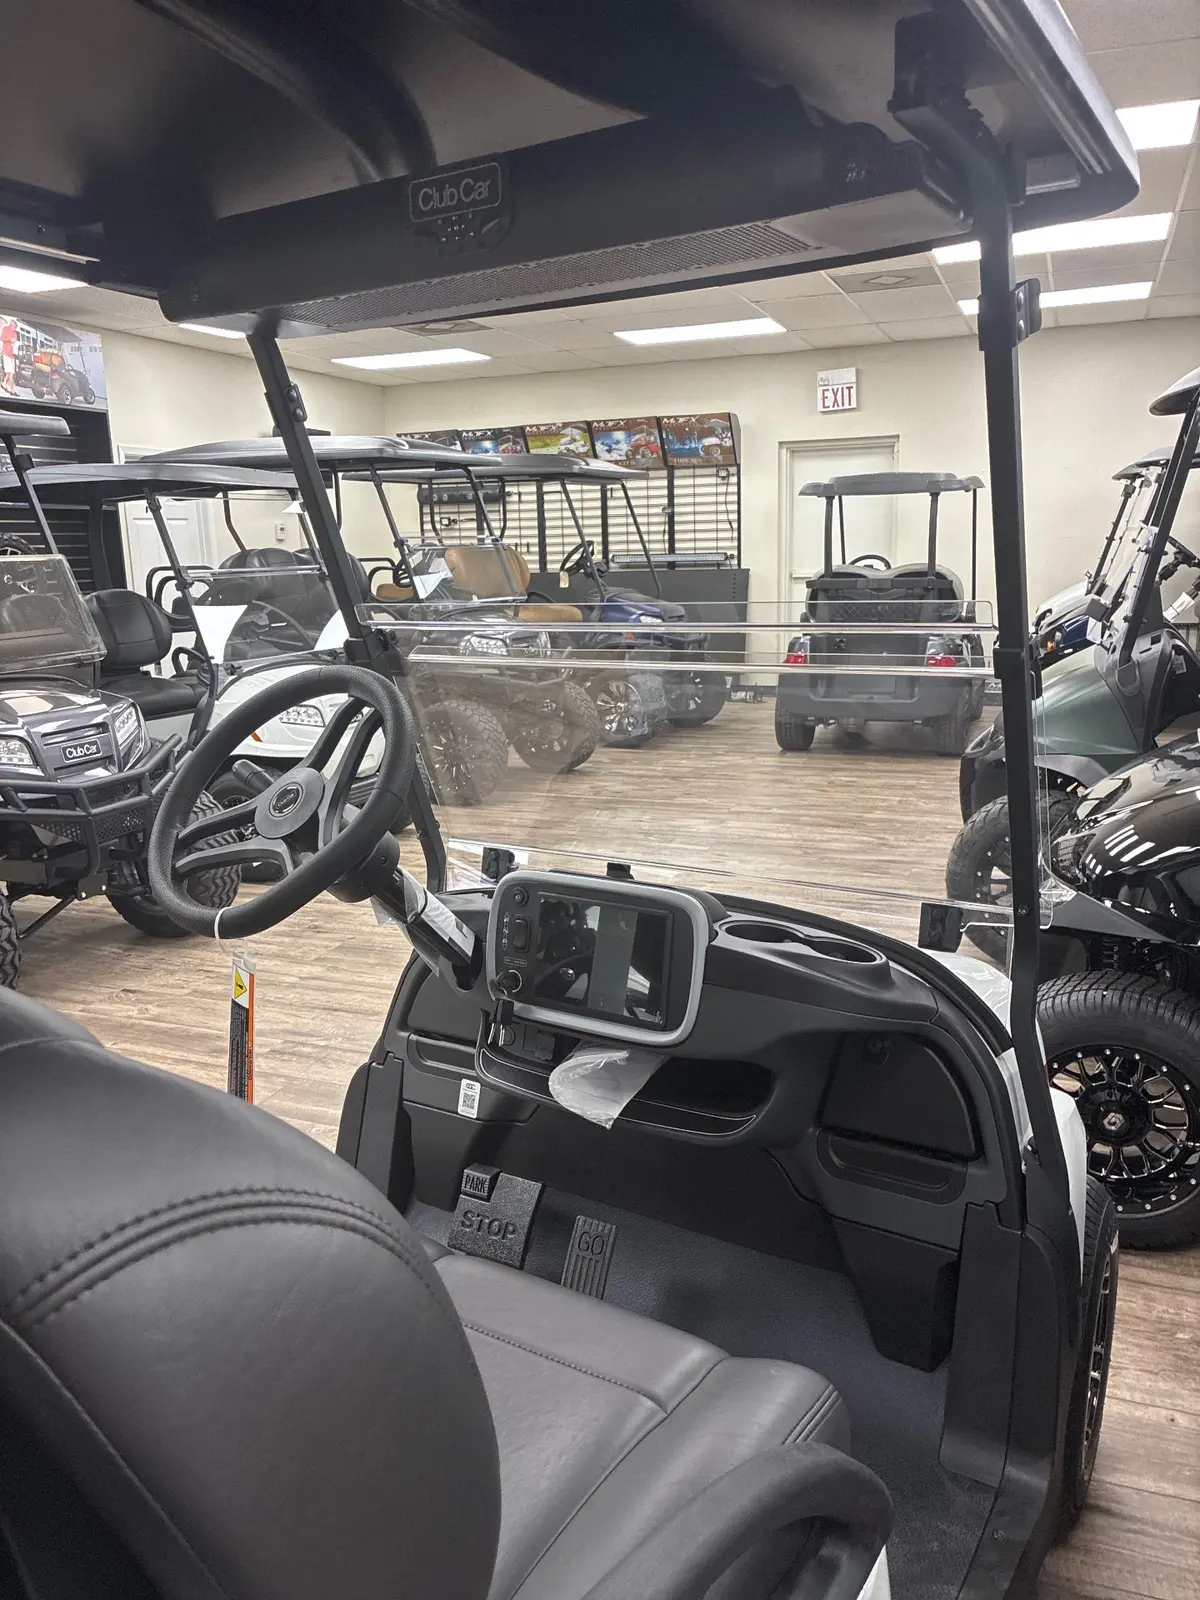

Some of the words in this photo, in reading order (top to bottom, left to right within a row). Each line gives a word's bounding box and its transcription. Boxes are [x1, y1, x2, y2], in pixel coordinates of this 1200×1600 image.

[418, 184, 458, 211] Club
[460, 178, 491, 202] Car
[822, 386, 854, 409] EXIT
[66, 746, 84, 758] Club
[84, 744, 97, 754] Car
[464, 1173, 487, 1194] PARK
[460, 1210, 518, 1241] STOP
[578, 1231, 605, 1256] GO
